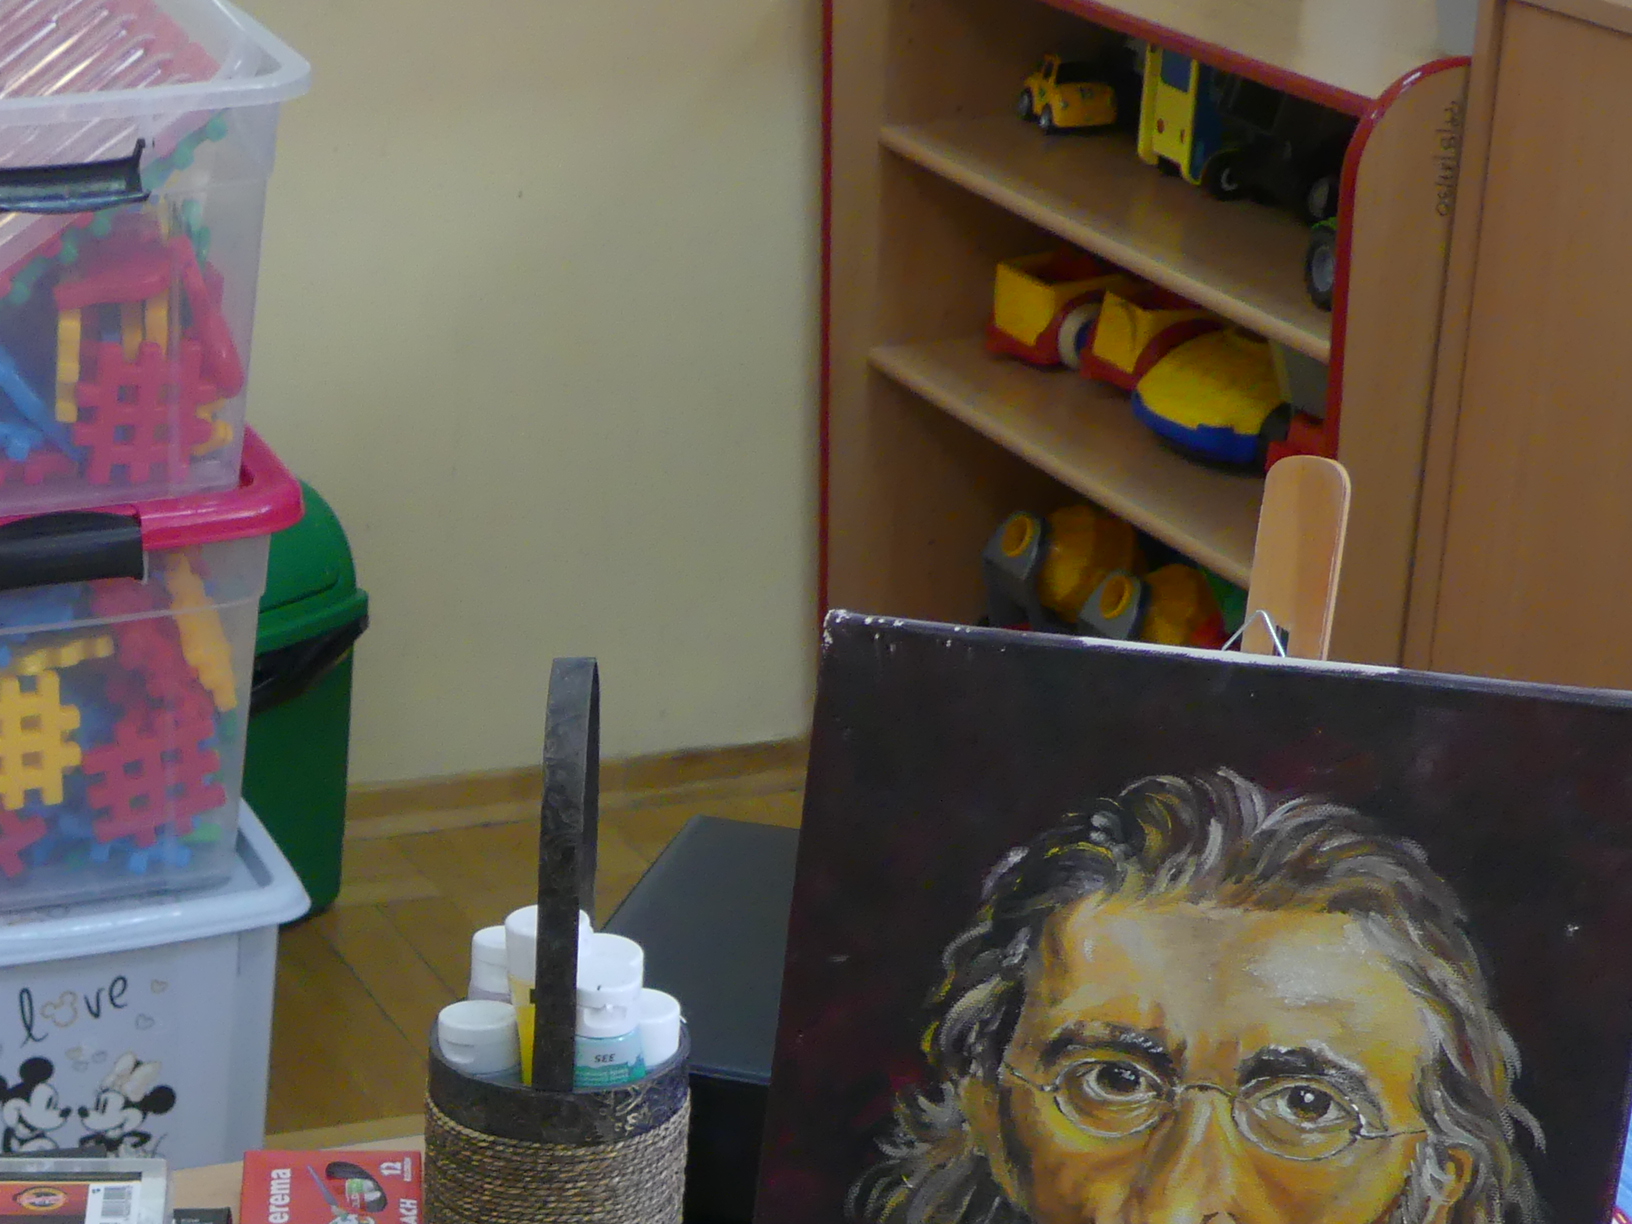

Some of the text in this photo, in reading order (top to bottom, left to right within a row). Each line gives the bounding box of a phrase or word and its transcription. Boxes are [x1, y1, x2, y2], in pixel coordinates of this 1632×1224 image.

[18, 975, 128, 1046] love
[268, 1167, 292, 1224] erema
[379, 1160, 403, 1177] 12
